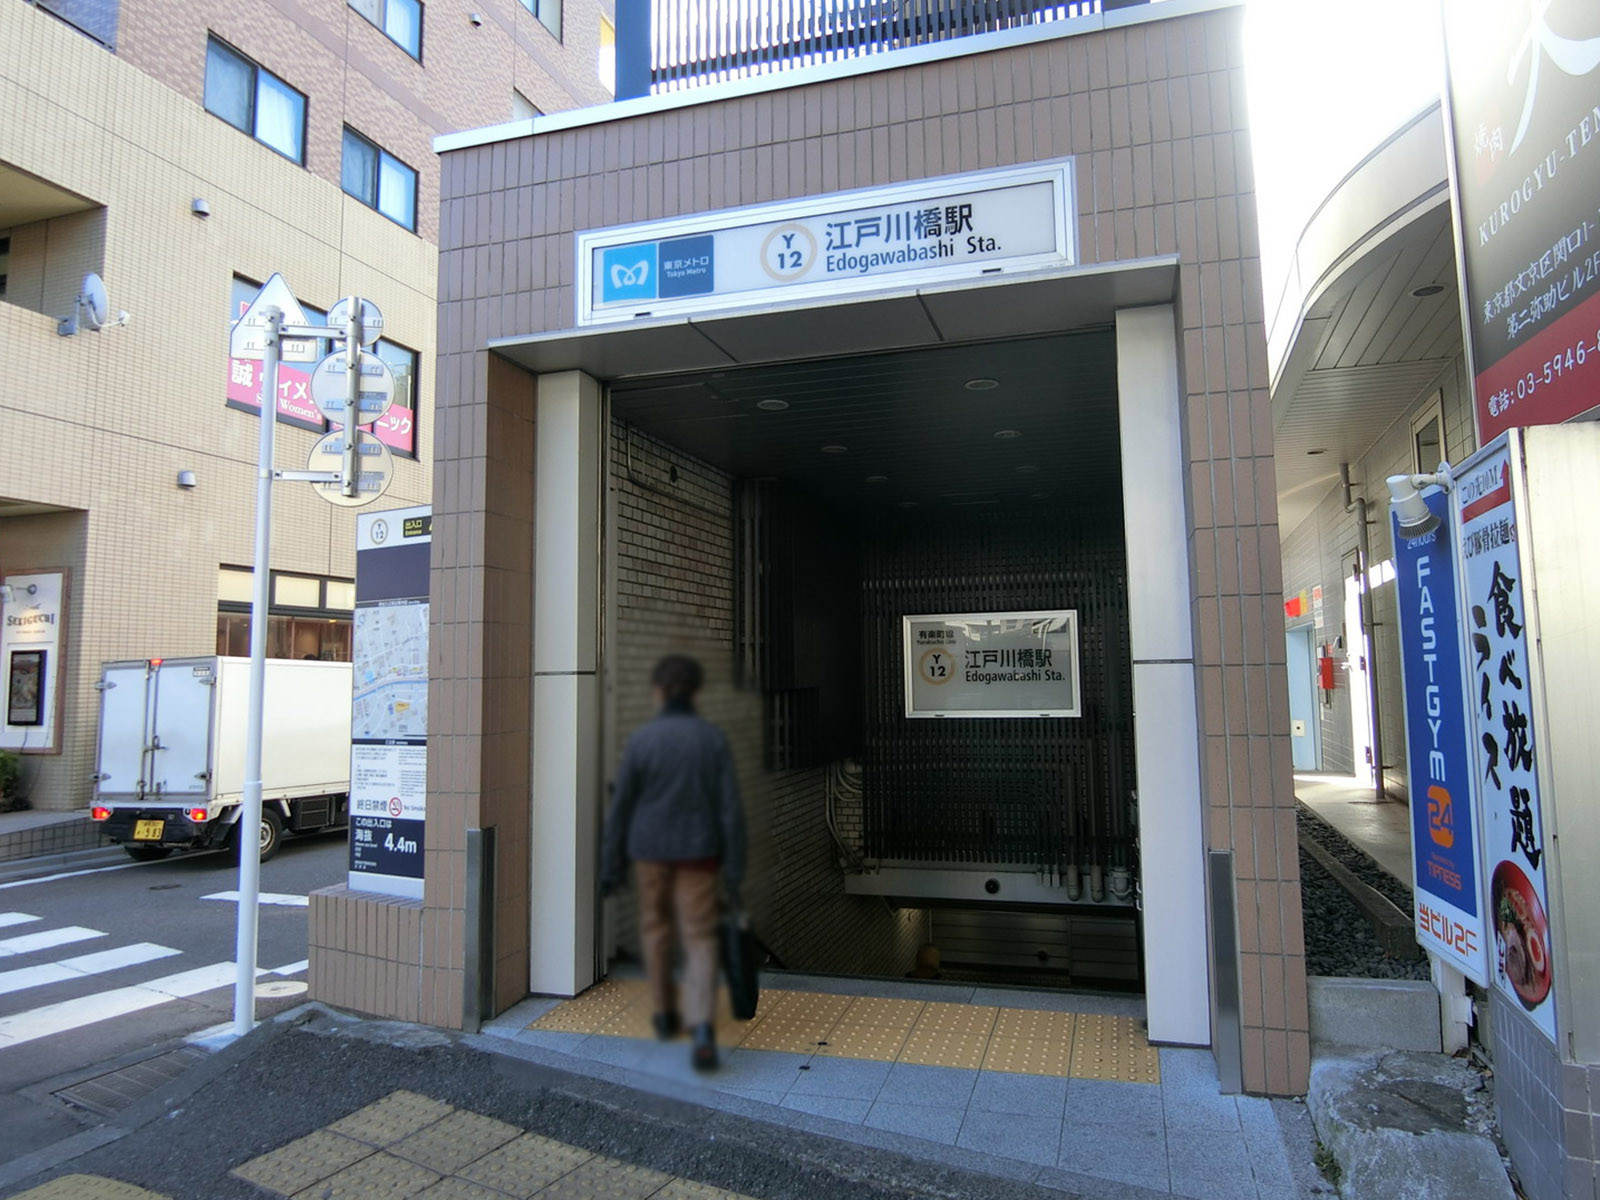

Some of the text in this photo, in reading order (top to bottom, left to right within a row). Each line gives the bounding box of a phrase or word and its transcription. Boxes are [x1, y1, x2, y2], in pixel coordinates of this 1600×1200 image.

[825, 203, 974, 251] 江戸川橋駅
[782, 233, 795, 250] Y
[663, 255, 710, 271] 東京メトロ
[778, 250, 803, 270] 12
[826, 235, 1002, 273] Edogawabashi Sta.
[667, 267, 707, 279] Tokyo Metro
[1484, 206, 1600, 324] 東京都文京区関口1-
[375, 530, 385, 540] 12
[919, 630, 954, 640] 有楽町線
[932, 653, 942, 665] Y
[965, 649, 1052, 669] 江戸川橋駅
[930, 665, 946, 677] 12
[965, 669, 1066, 685] Edogawabashi Sta.
[1416, 555, 1446, 782] FASTGYM
[1472, 605, 1501, 790] ライス
[1487, 561, 1542, 871] 食べ放題
[356, 799, 388, 812] 終日禁煙
[355, 817, 393, 829] この出入口は
[384, 832, 418, 854] 4.4m
[1419, 901, 1478, 957] 当ビル2F
